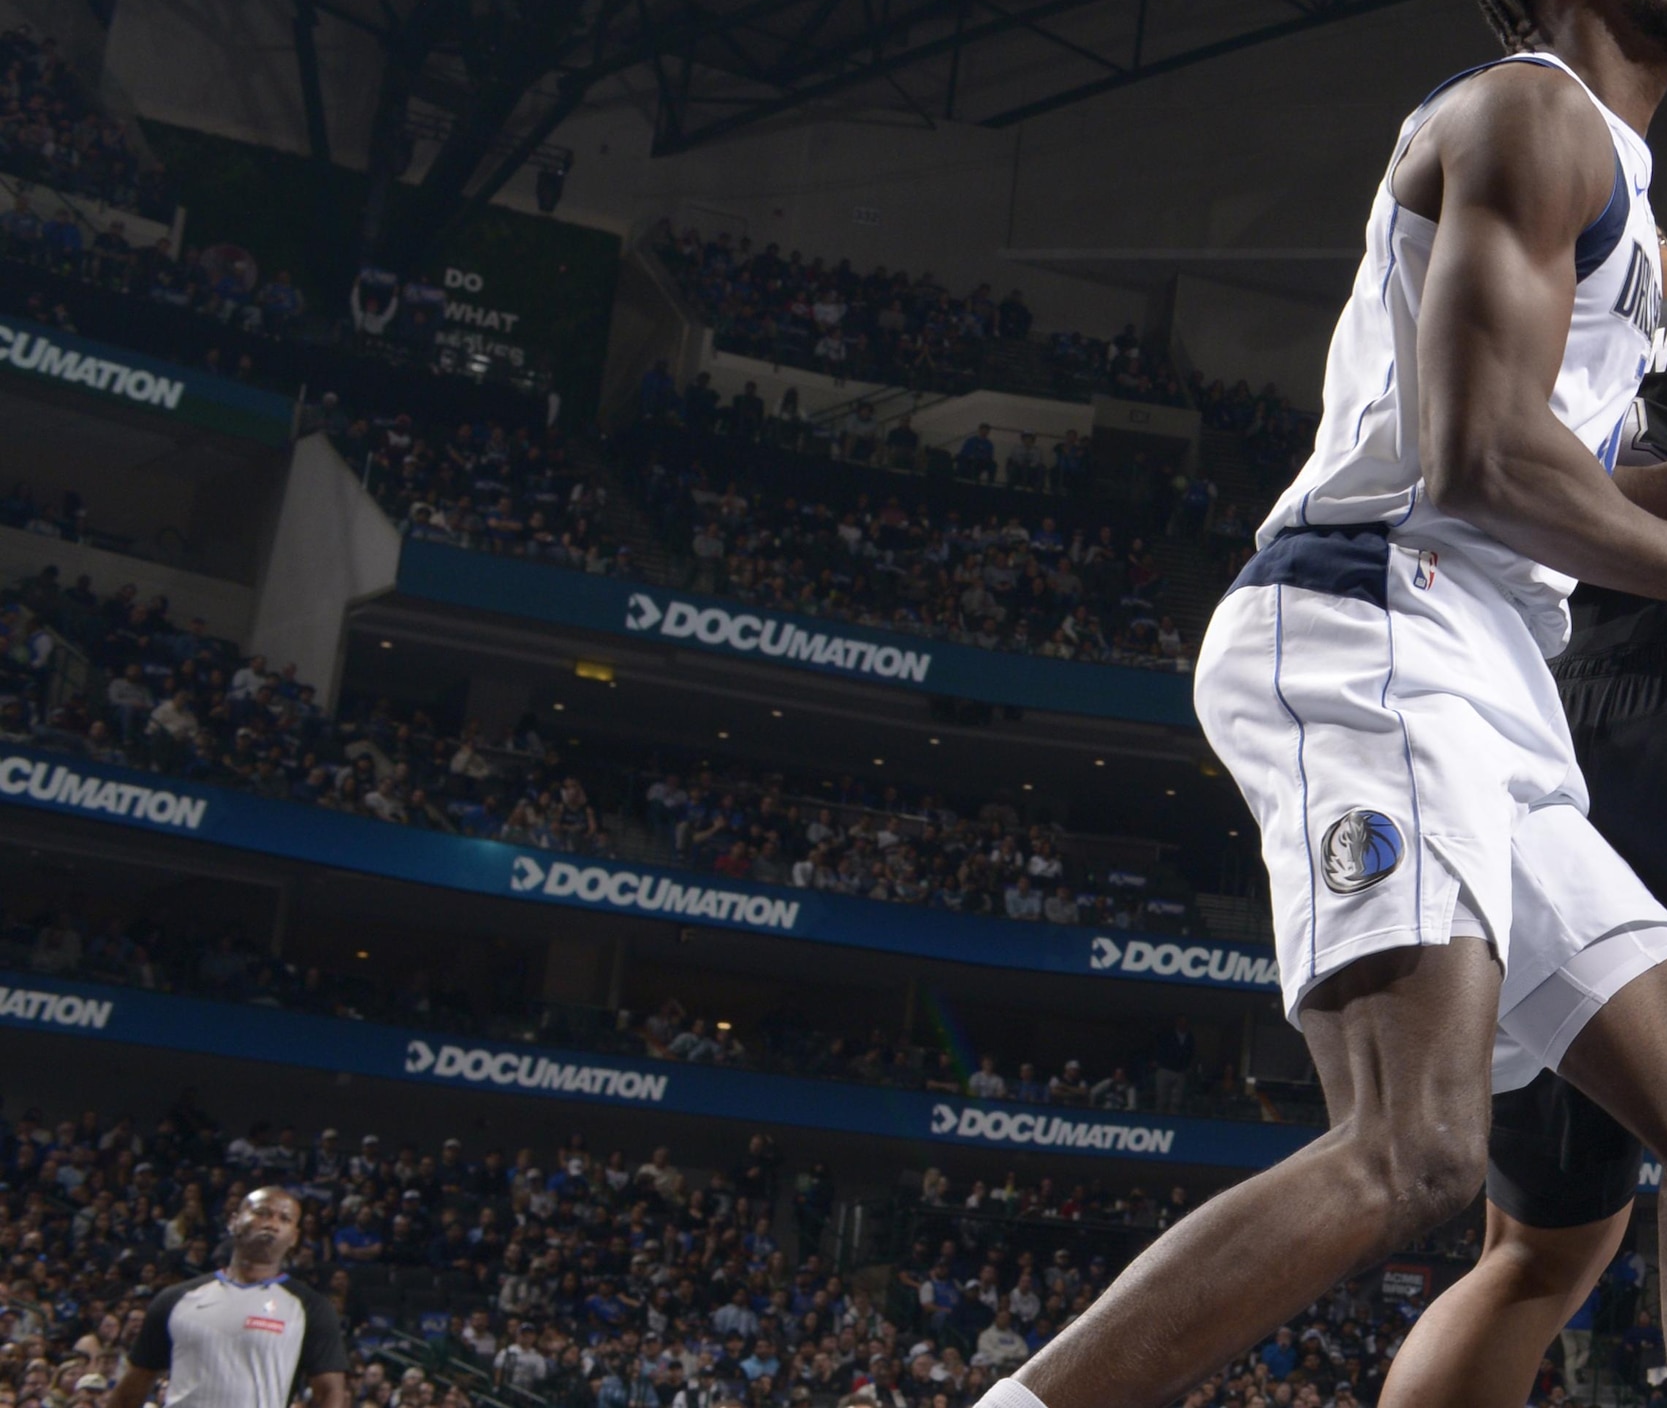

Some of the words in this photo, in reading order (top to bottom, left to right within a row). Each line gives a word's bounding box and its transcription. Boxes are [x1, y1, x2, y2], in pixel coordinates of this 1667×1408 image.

[444, 267, 484, 293] DO
[0, 324, 184, 410] CUMATION
[662, 600, 931, 684] DOCUMATION
[0, 755, 207, 831] CUMATION
[541, 859, 800, 932] DOCUMATION
[1120, 939, 1278, 987] DOCUMA
[433, 1043, 668, 1103] DOCUMATION
[957, 1105, 1174, 1156] DOCUMATION
